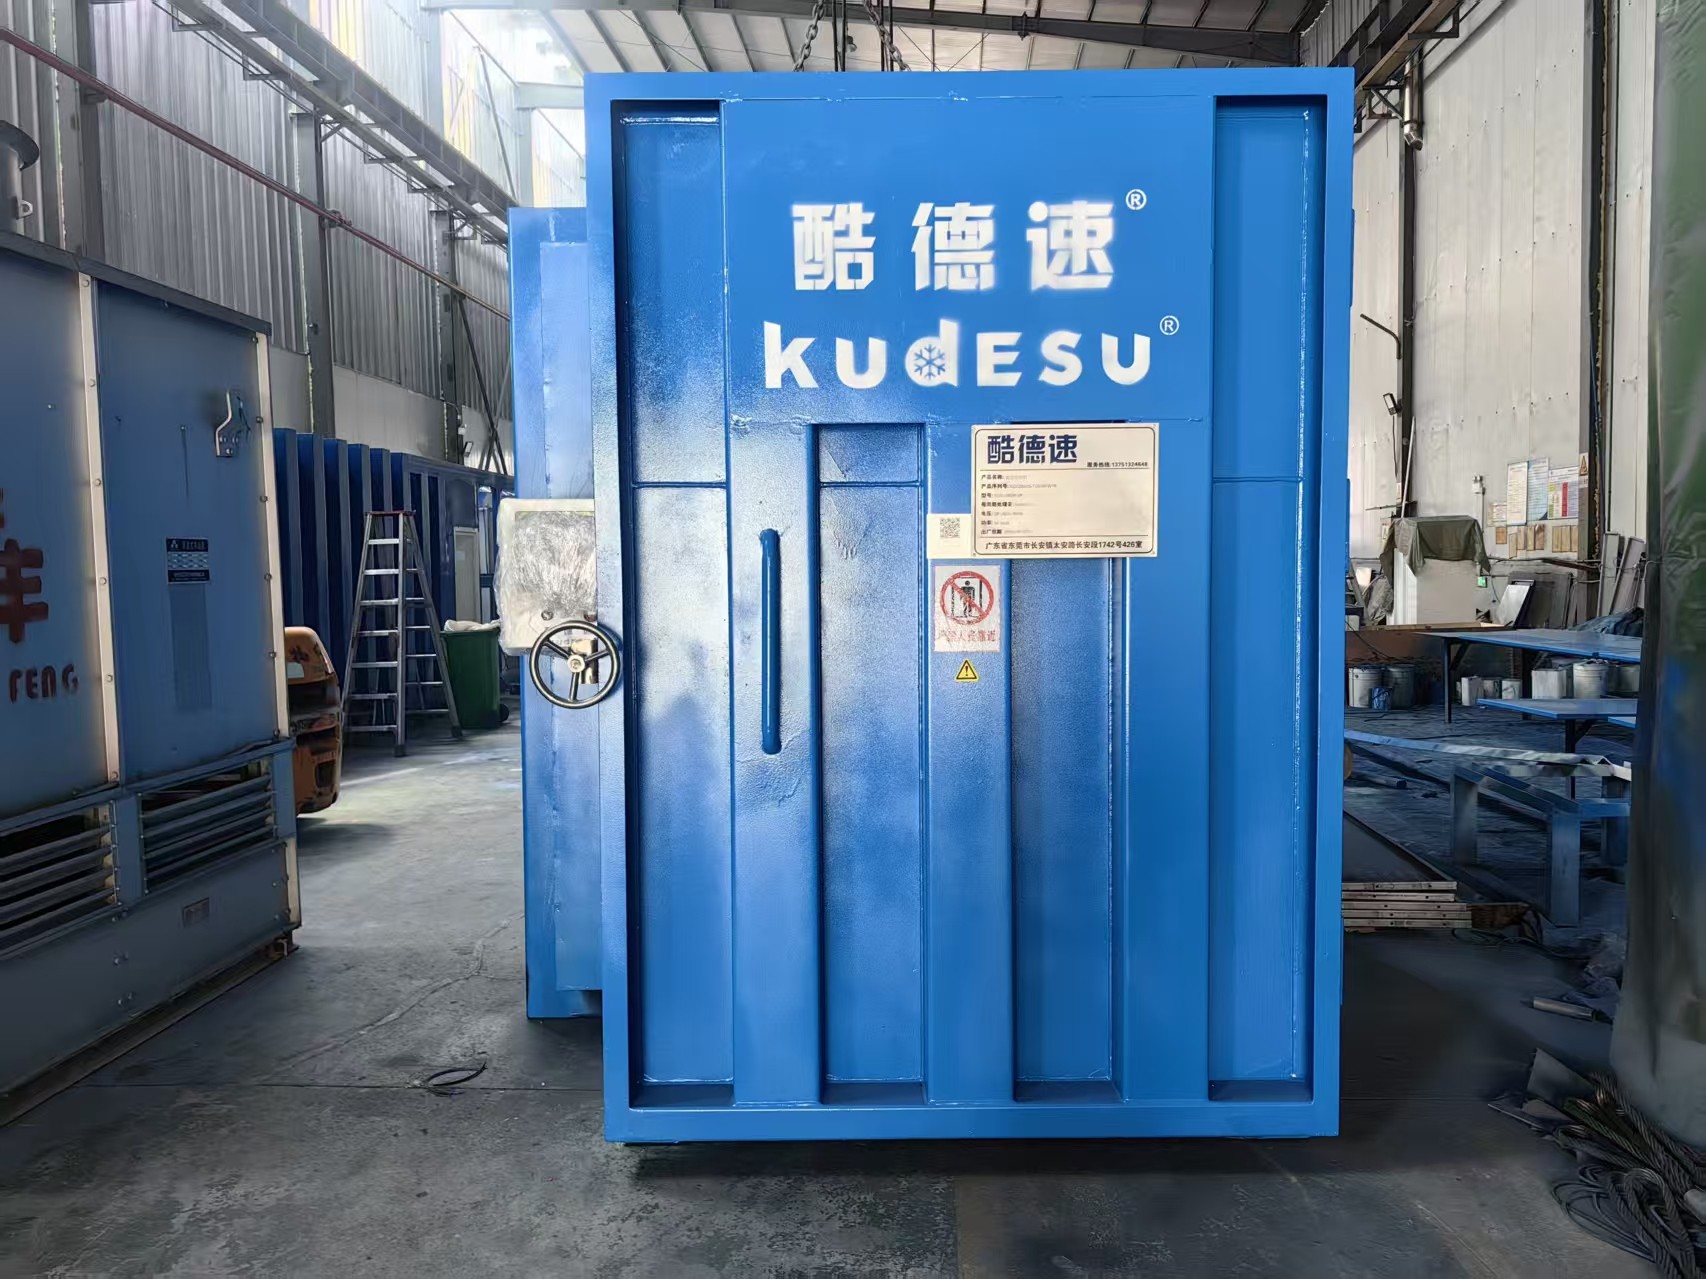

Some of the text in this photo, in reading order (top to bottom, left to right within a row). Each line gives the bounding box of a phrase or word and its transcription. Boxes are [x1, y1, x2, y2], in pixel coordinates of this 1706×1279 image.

[790, 200, 1115, 292] 酷德速
[987, 434, 1077, 465] 酷德速
[8, 663, 79, 704] FENG
